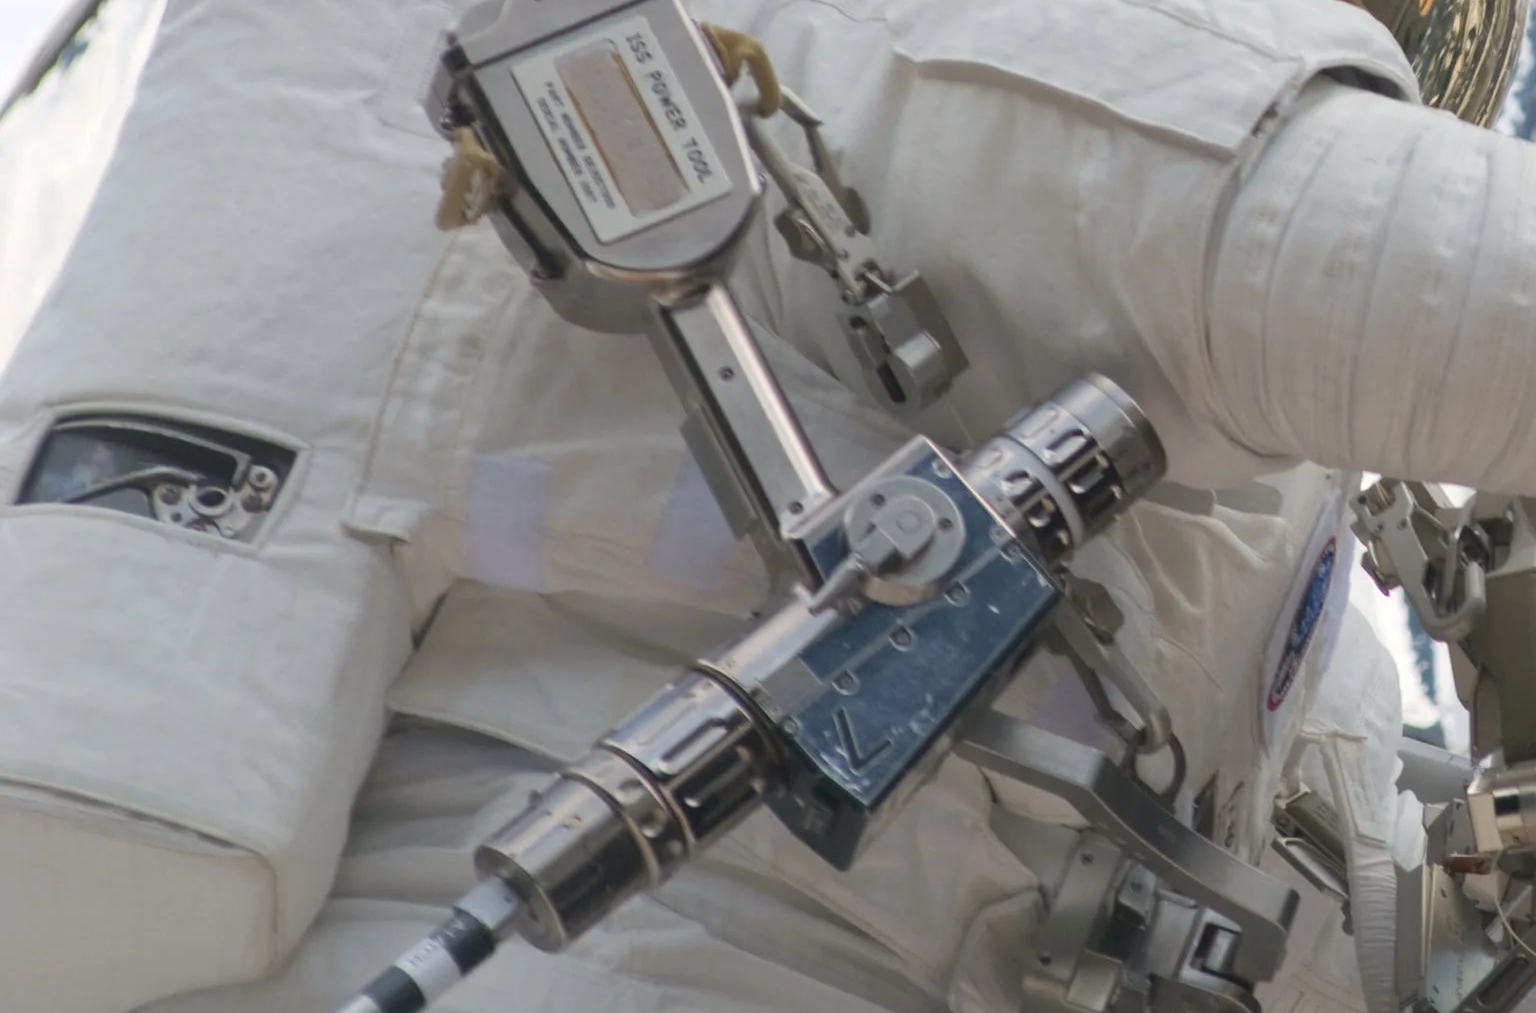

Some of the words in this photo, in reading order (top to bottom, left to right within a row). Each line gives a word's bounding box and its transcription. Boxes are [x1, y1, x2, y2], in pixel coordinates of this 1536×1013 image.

[626, 32, 653, 64] ISS
[647, 69, 688, 132] POWER
[683, 137, 714, 185] TOOL
